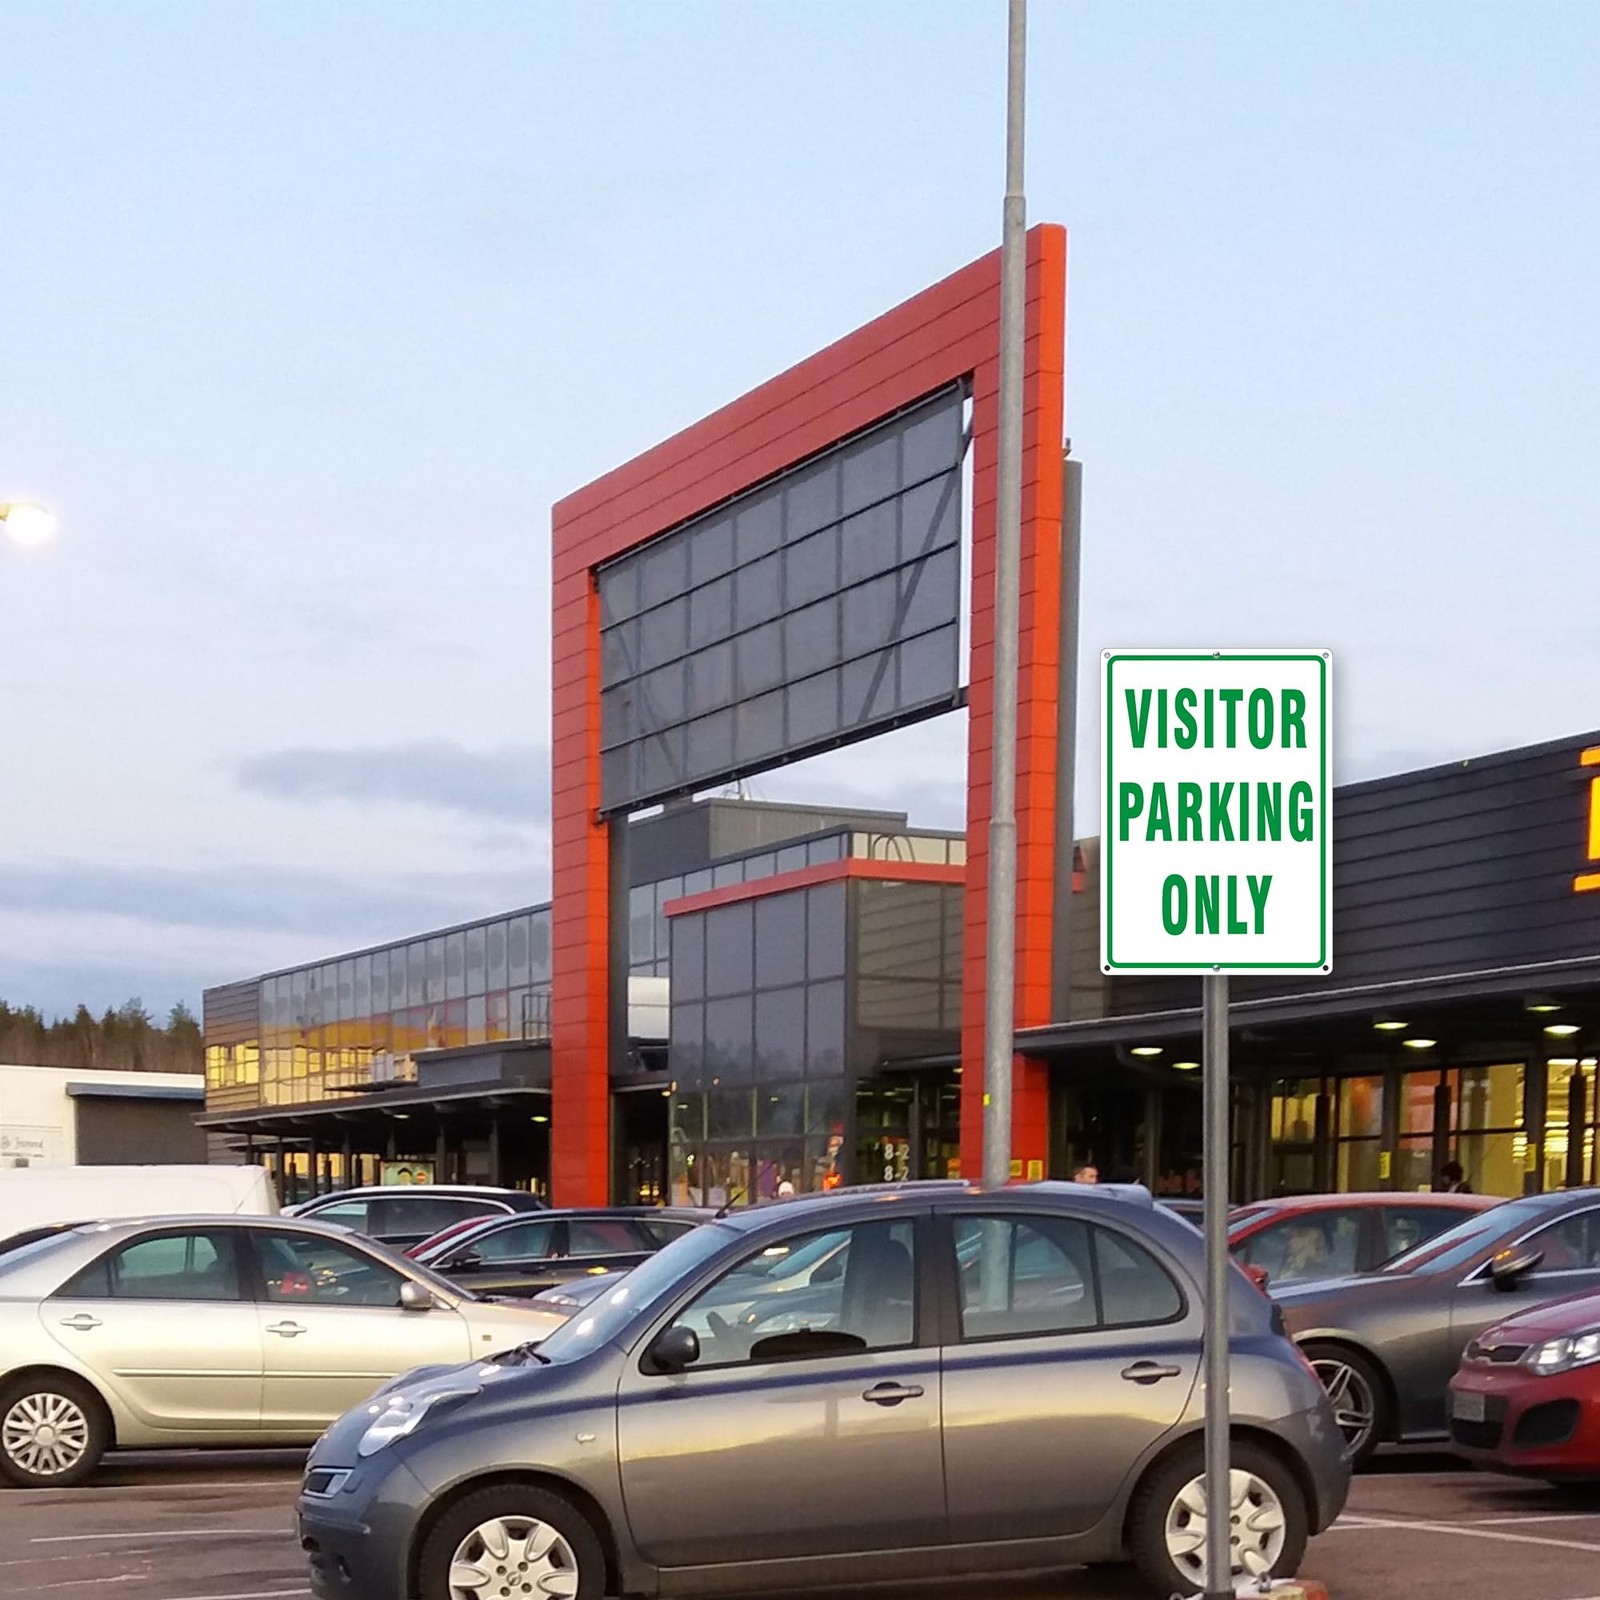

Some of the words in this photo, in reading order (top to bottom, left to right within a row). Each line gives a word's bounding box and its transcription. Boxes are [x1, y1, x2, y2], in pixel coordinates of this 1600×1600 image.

[1124, 687, 1308, 750] VISITOR
[1119, 780, 1314, 843] PARKING
[1161, 873, 1273, 936] ONLY
